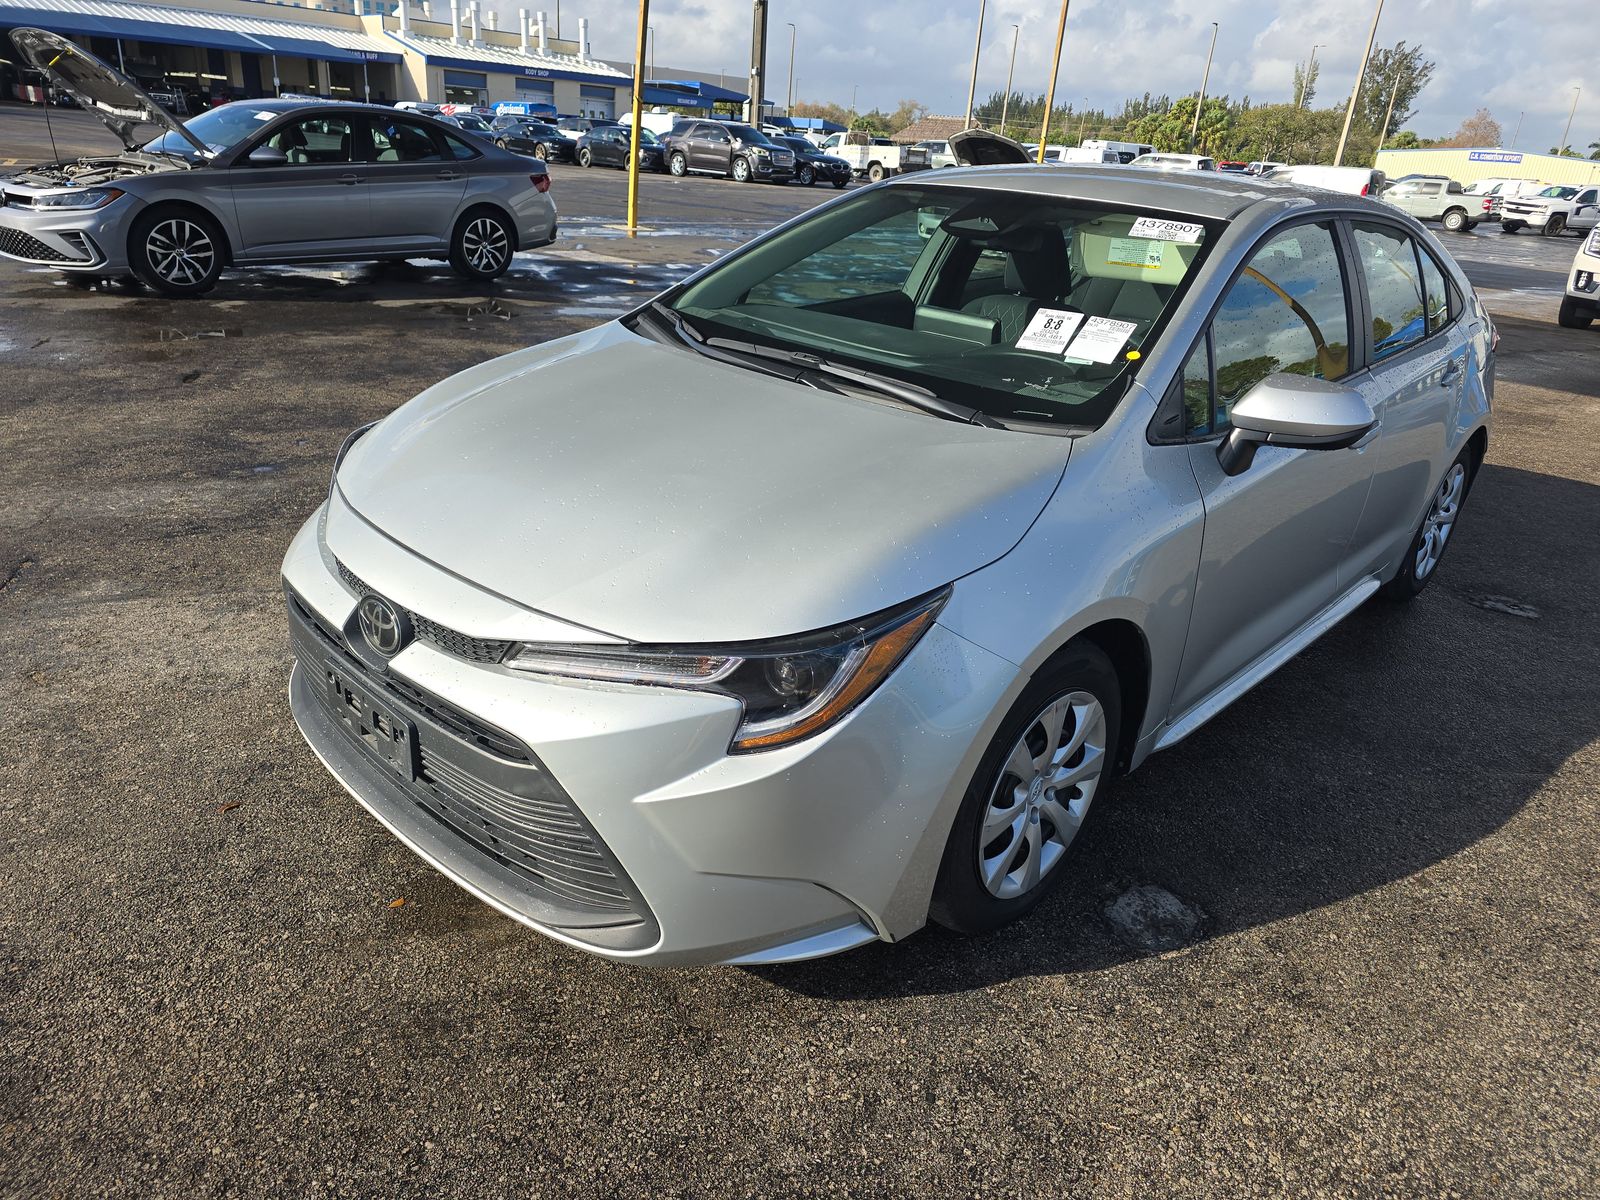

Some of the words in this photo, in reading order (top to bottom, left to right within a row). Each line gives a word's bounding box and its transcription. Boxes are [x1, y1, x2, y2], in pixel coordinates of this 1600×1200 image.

[525, 68, 537, 76] BODY
[1138, 219, 1201, 234] 4378907
[1044, 318, 1064, 330] 8:8
[1090, 317, 1137, 330] 4378907
